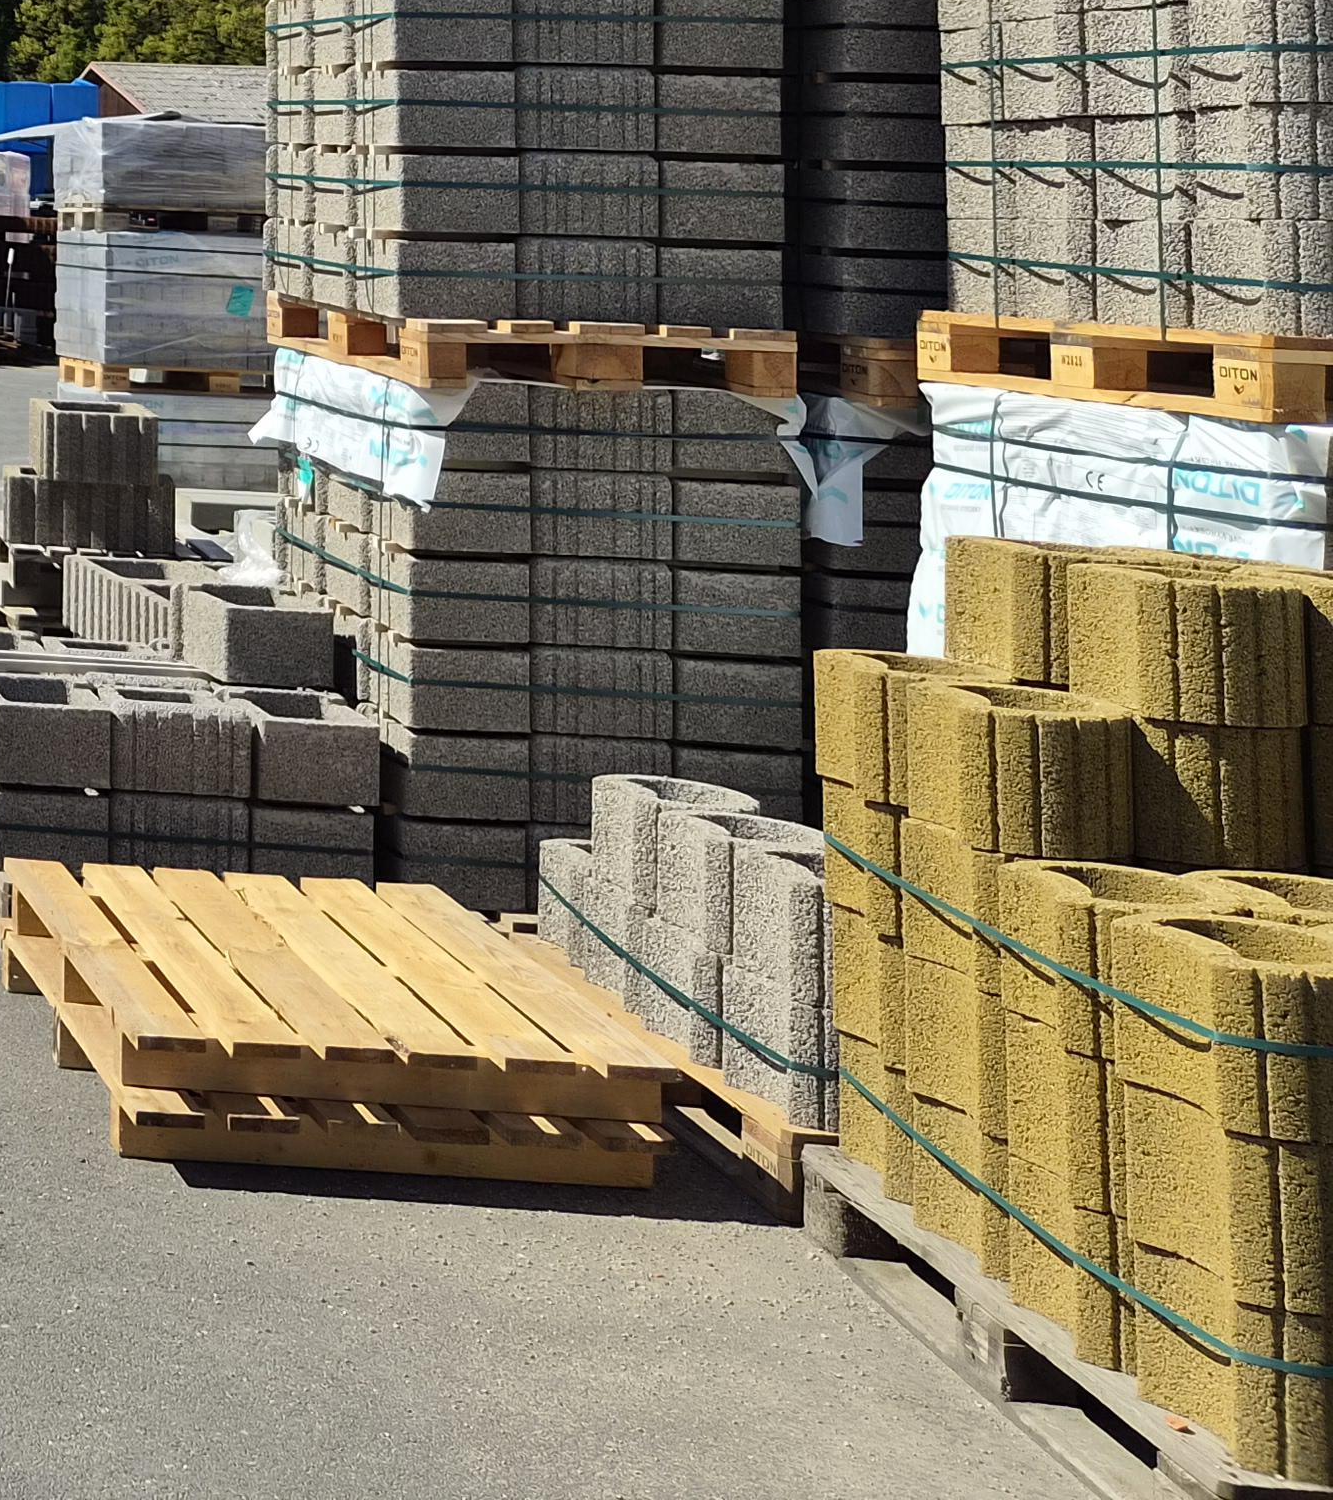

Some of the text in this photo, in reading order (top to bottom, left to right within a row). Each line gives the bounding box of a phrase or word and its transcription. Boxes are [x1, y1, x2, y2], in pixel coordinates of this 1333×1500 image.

[919, 338, 947, 353] DITON
[841, 362, 868, 375] DITON
[1219, 365, 1259, 383] DITON
[944, 482, 991, 500] DITON
[1173, 467, 1261, 506] DITON
[745, 1142, 779, 1177] DITON
